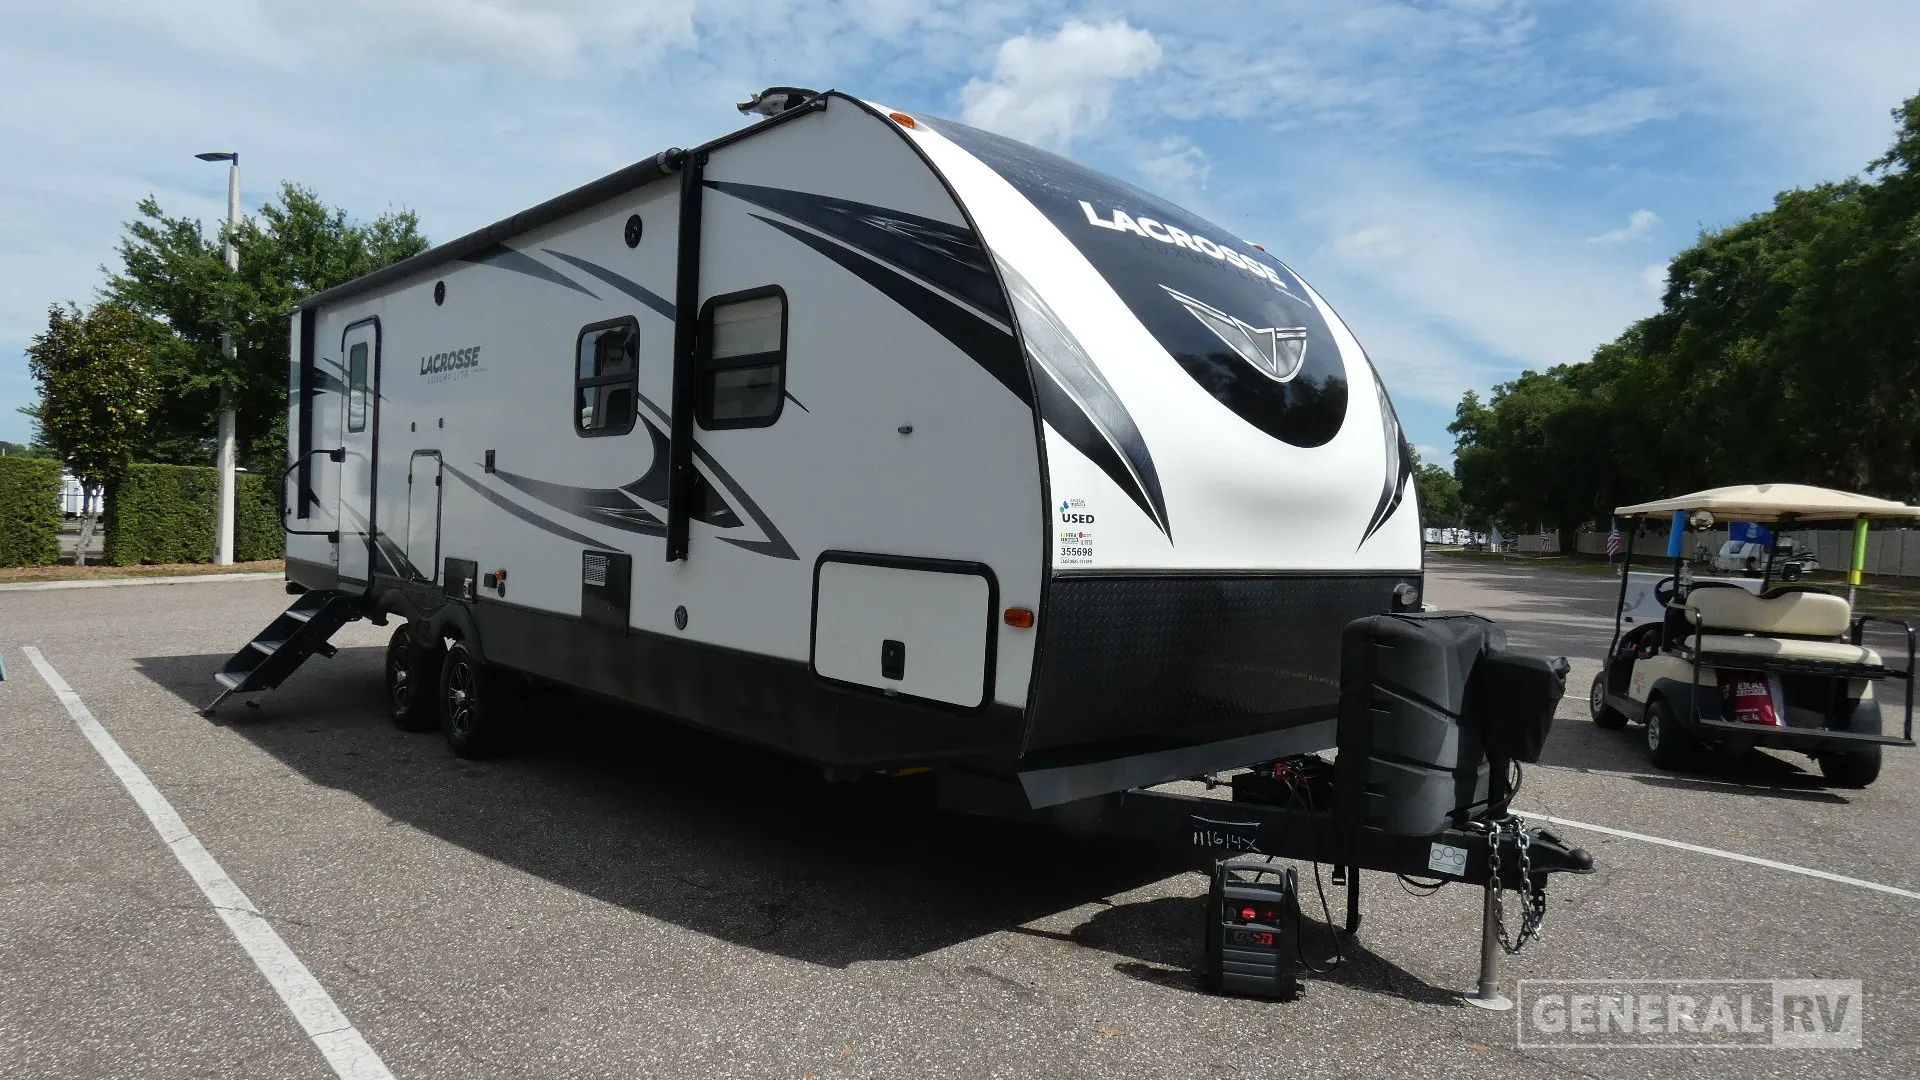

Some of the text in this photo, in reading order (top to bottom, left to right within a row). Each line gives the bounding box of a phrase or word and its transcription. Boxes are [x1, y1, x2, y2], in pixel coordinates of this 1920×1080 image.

[1079, 200, 1288, 289] LACROSSE
[1140, 240, 1228, 272] LUXURY
[420, 346, 481, 376] LACROSSE
[453, 370, 470, 381] LITE
[1062, 513, 1095, 524] USED
[1060, 547, 1093, 557] 355698
